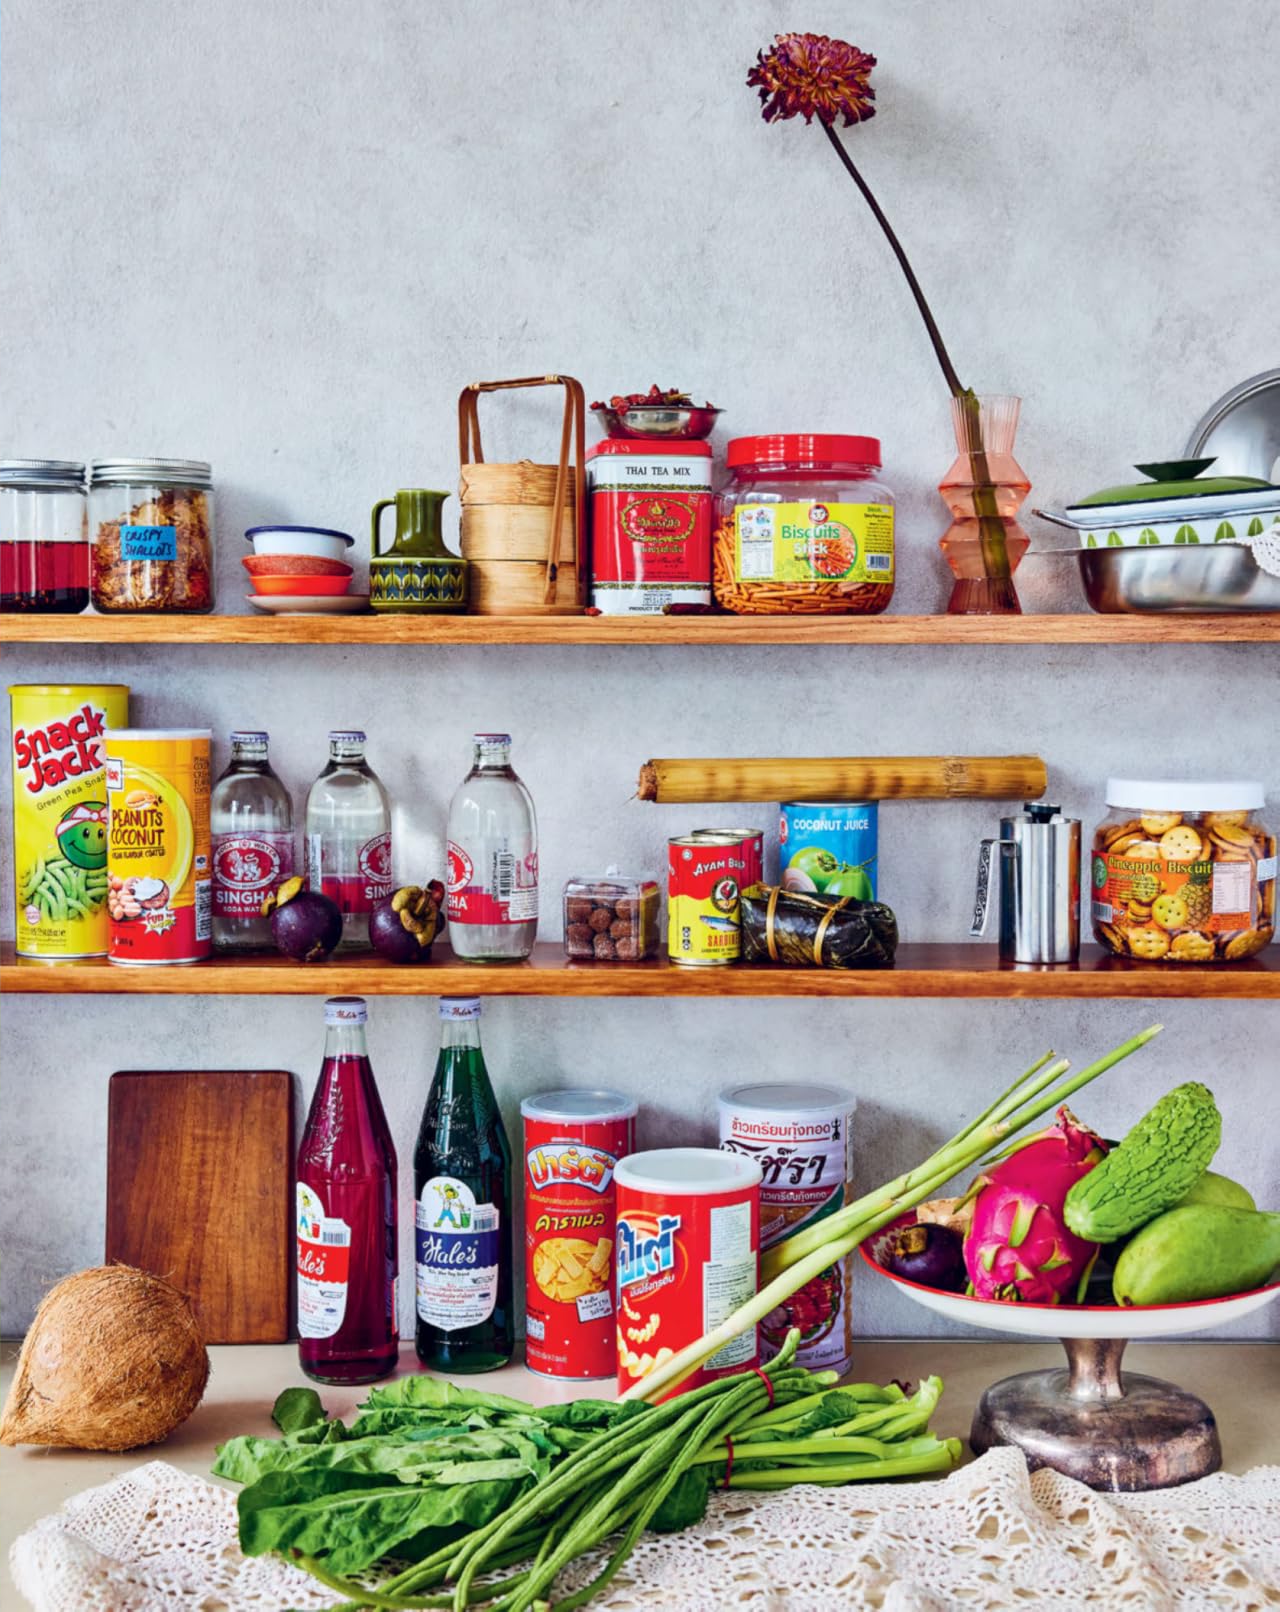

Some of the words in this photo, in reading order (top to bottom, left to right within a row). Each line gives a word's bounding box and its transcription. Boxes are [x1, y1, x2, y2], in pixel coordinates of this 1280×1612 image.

[625, 466, 647, 475] THAI
[651, 466, 669, 476] TEA
[673, 467, 691, 476] MIX
[125, 529, 163, 541] CRISPY
[781, 524, 841, 539] Biscuits
[125, 542, 173, 557] SHALLOTS
[15, 705, 106, 769] Snack
[27, 742, 104, 793] Jack
[36, 795, 62, 811] Green
[64, 785, 82, 797] Pea
[112, 809, 163, 828] PEANUTS
[794, 819, 842, 831] COCONUT
[844, 819, 869, 831] JUICE
[111, 829, 164, 846] COCONUT
[693, 862, 725, 877] AYAM
[1108, 856, 1163, 873] Pineapple
[1168, 861, 1211, 874] Biscuit
[216, 891, 275, 904] SINGHA
[535, 1213, 605, 1232] คาราเมล
[422, 1234, 477, 1264] Hale's
[299, 1244, 325, 1276] ale's
